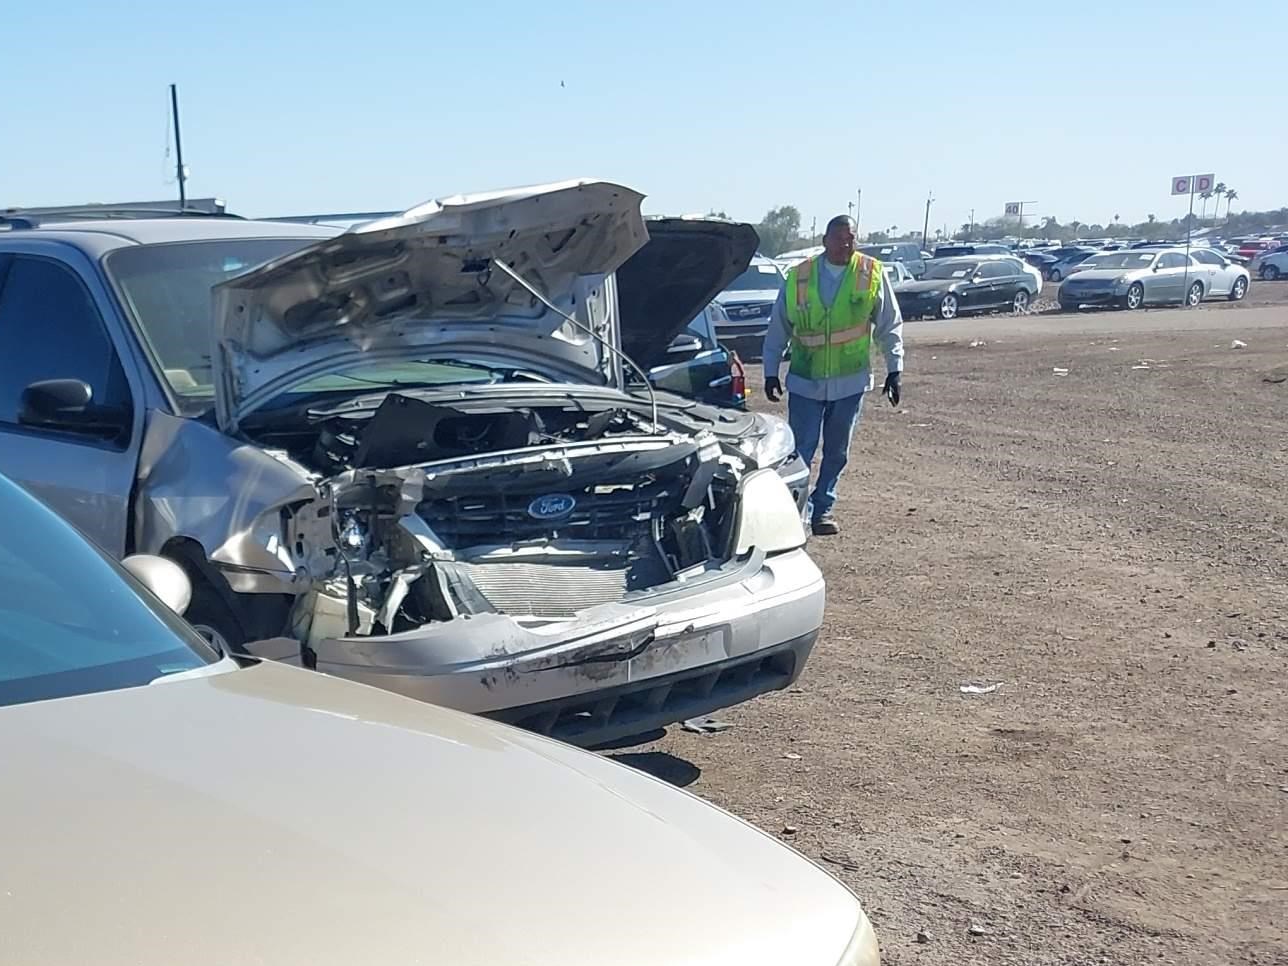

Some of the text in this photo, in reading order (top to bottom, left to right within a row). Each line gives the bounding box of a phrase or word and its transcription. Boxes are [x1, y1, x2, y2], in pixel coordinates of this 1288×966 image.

[1175, 179, 1187, 192] C
[1198, 177, 1210, 191] D
[1005, 205, 1019, 214] 40
